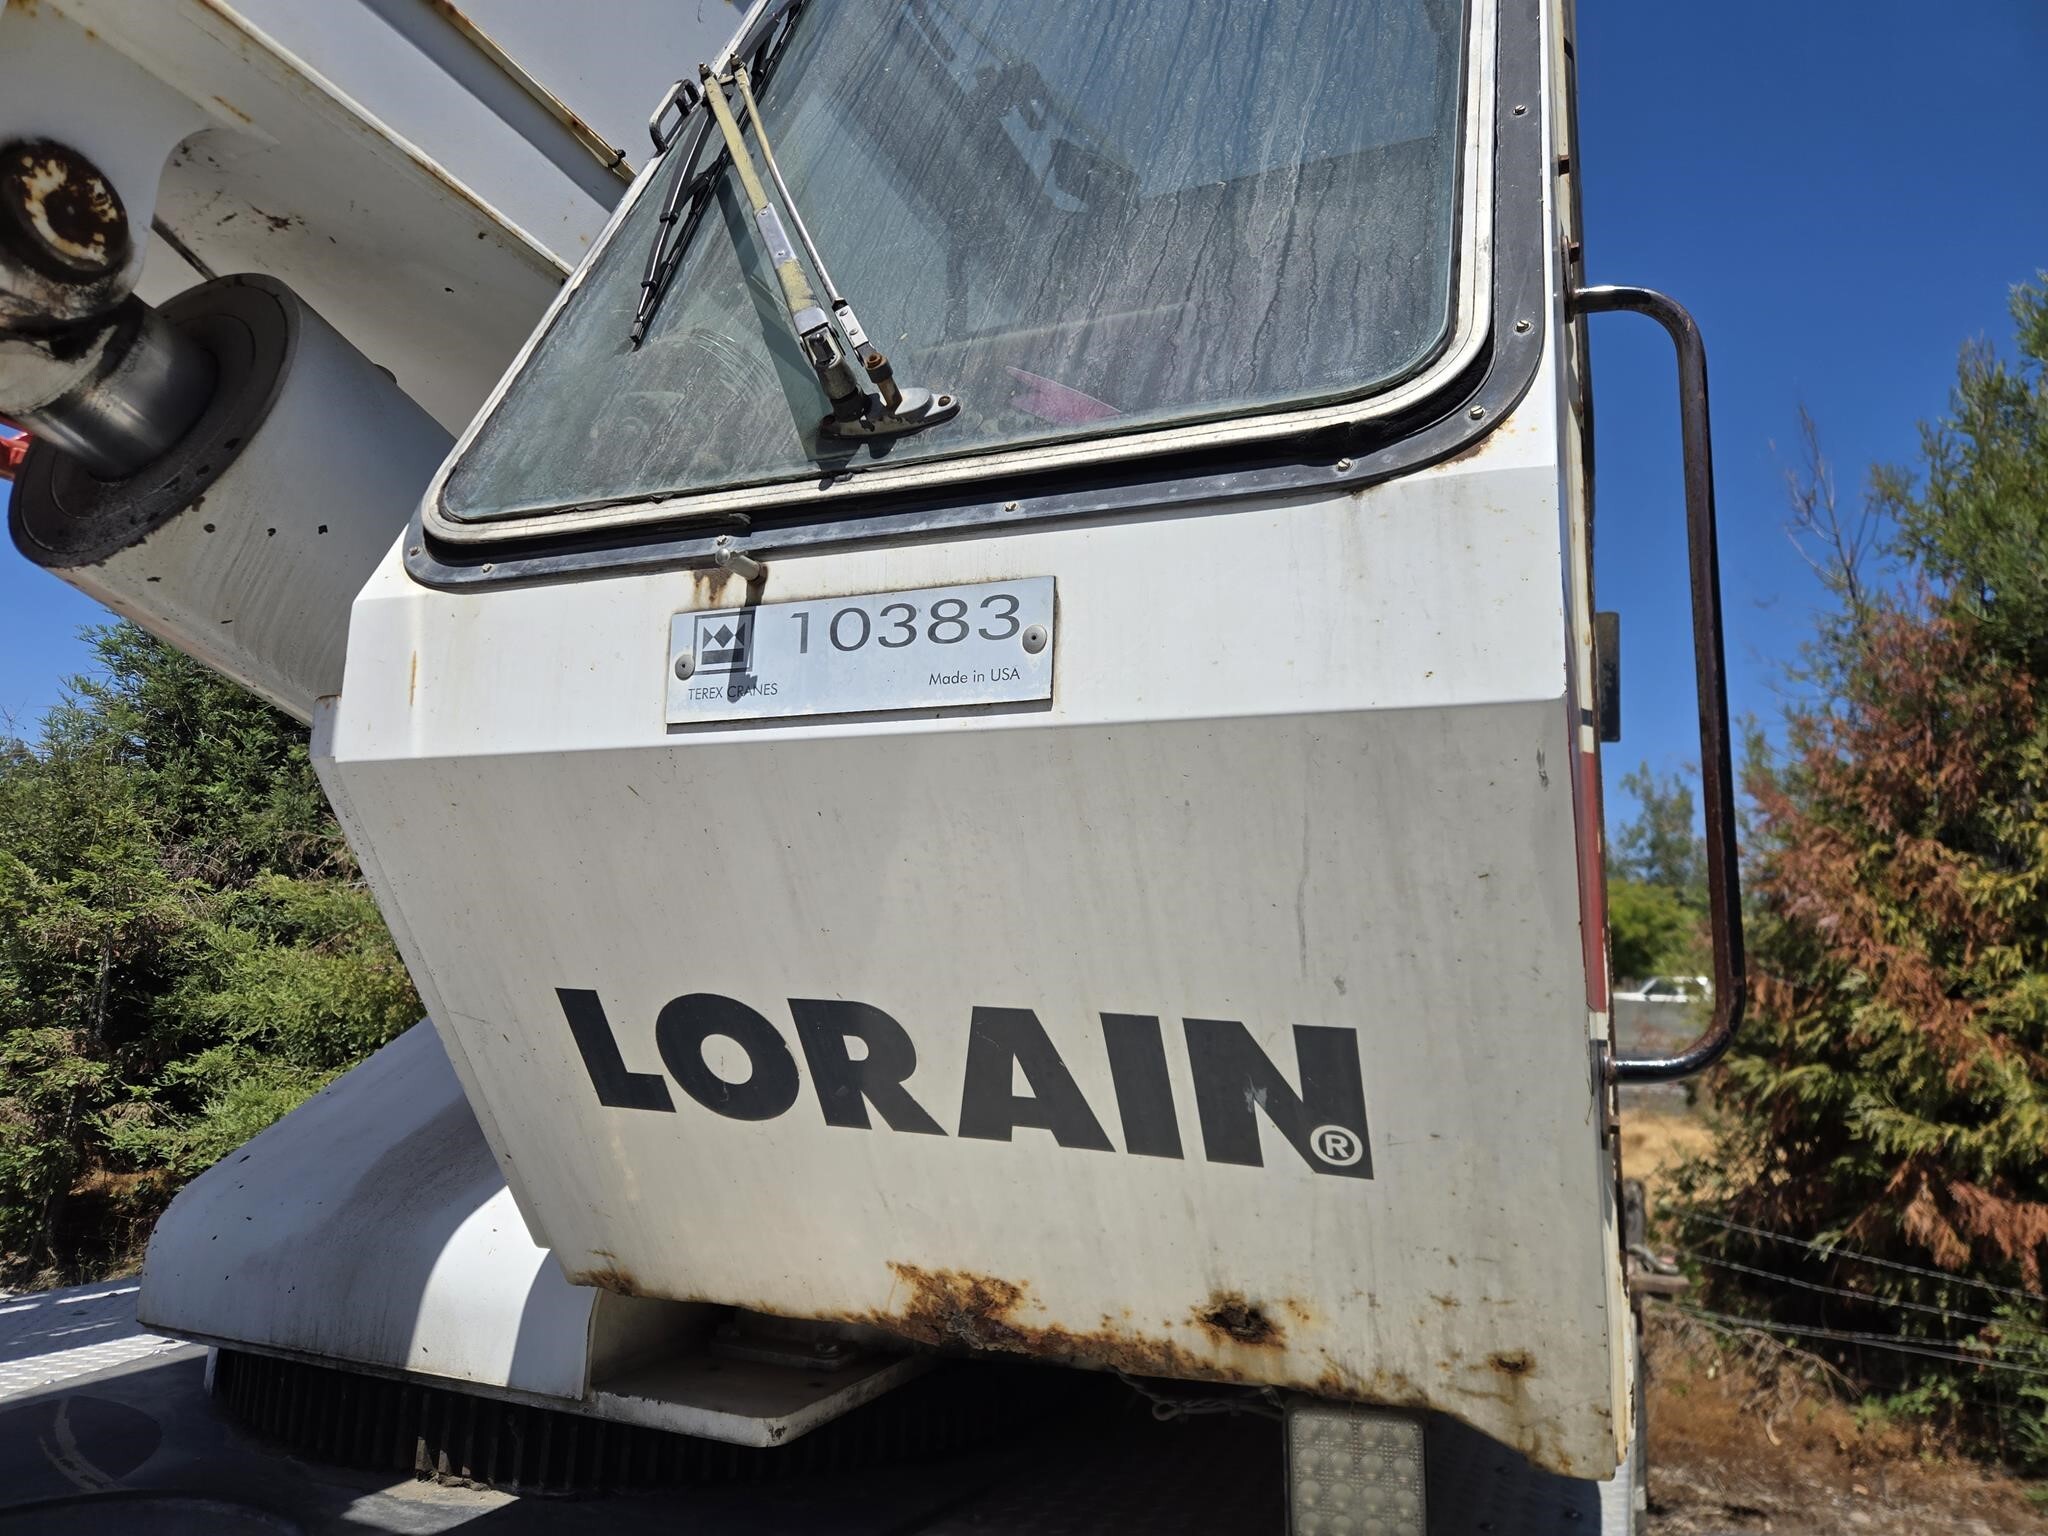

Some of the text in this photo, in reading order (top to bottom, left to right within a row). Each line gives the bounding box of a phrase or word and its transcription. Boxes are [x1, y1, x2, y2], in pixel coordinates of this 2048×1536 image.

[790, 594, 1020, 654] 10383
[929, 667, 1021, 686] Made in USA
[688, 683, 777, 700] TEREX CRANES
